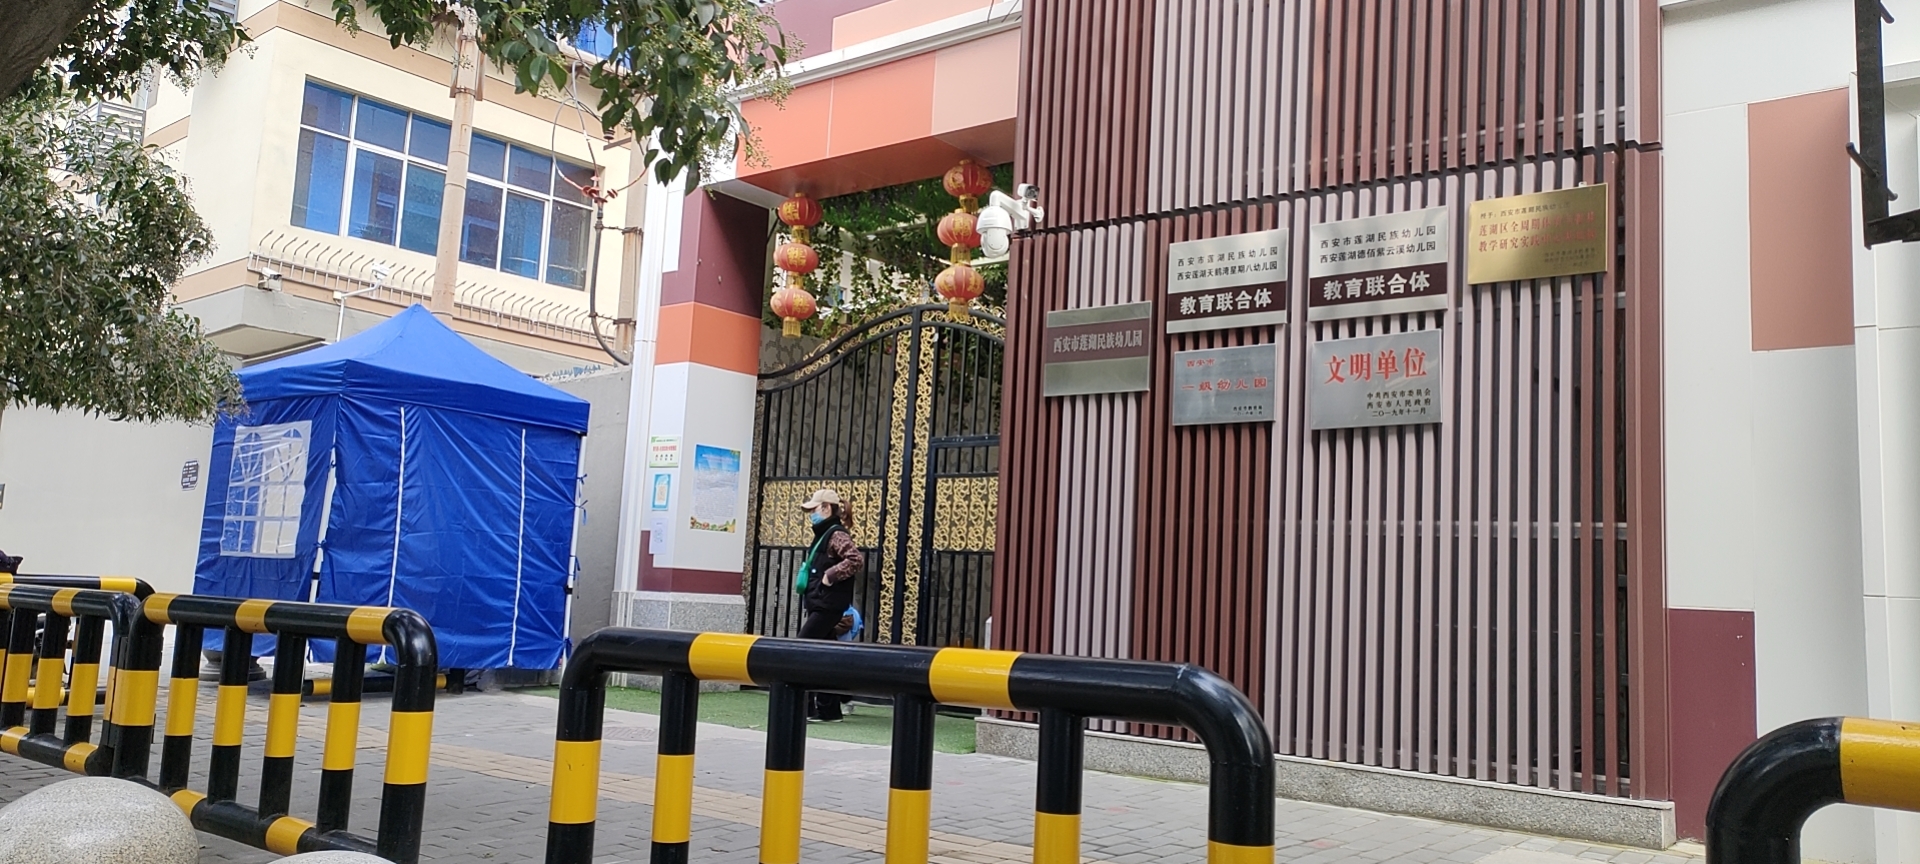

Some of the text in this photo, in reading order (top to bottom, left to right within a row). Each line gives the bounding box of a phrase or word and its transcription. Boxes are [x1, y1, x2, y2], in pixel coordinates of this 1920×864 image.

[1320, 225, 1436, 249] 西安市莲湖民族幼儿园
[1478, 229, 1596, 252] 教学研究实践中心
[1177, 246, 1278, 267] 西安市莲湖民族幼儿园
[1320, 241, 1436, 263] 西安莲湖德佰紫云溪幼儿园
[1323, 270, 1430, 300] 教育联合体
[1180, 288, 1272, 315] 教育联合体
[1053, 329, 1143, 353] 西安市莲湖民族幼儿园
[1186, 358, 1215, 368] 西安市
[1324, 347, 1427, 385] 文明单位
[1181, 376, 1267, 391] 一级幼儿园
[1366, 387, 1431, 400] 中共西安市委员会
[1366, 397, 1431, 409] 西安市人民政府
